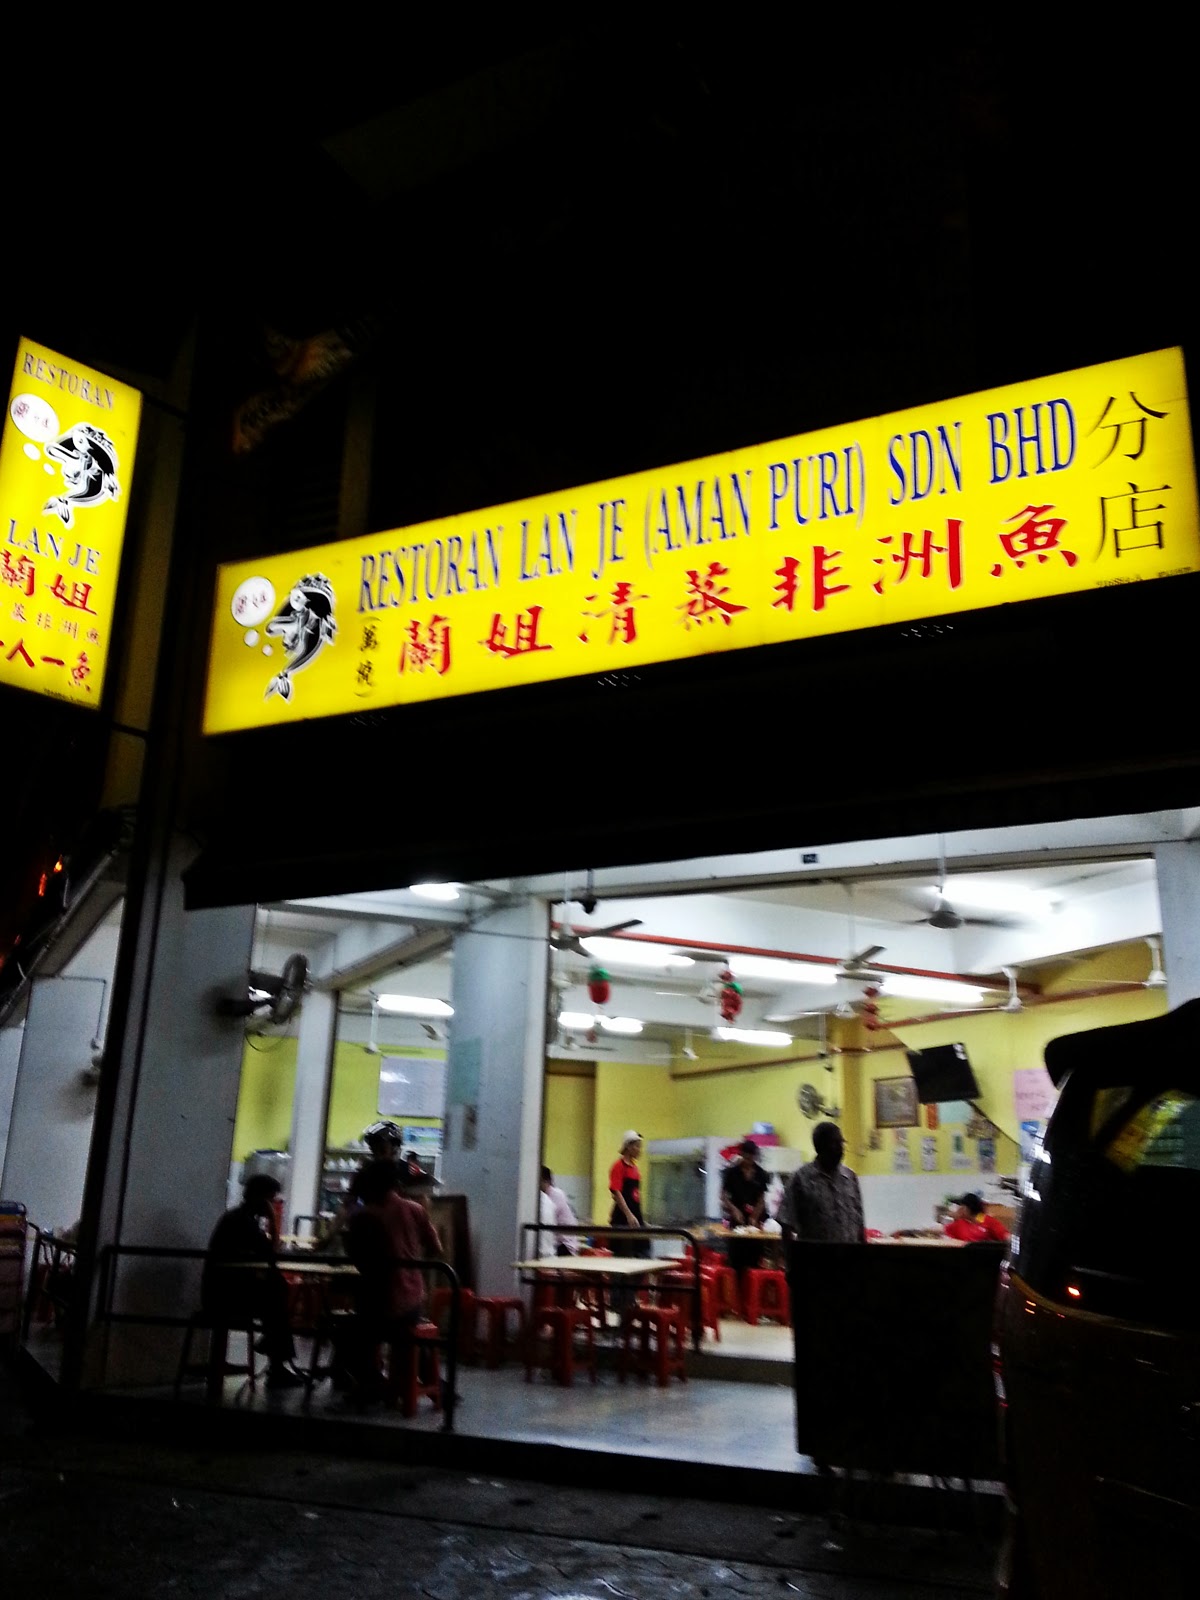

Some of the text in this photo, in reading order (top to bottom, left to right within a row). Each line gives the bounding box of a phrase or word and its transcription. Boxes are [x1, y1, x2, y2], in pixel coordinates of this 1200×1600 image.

[23, 352, 116, 411] RESTORAN
[358, 397, 1077, 614] RESTORAN LAN JE (AMAN PURI) SDN BHD
[1085, 391, 1173, 562] 分店
[6, 519, 102, 575] LAN JE
[0, 637, 92, 692] 人一魚
